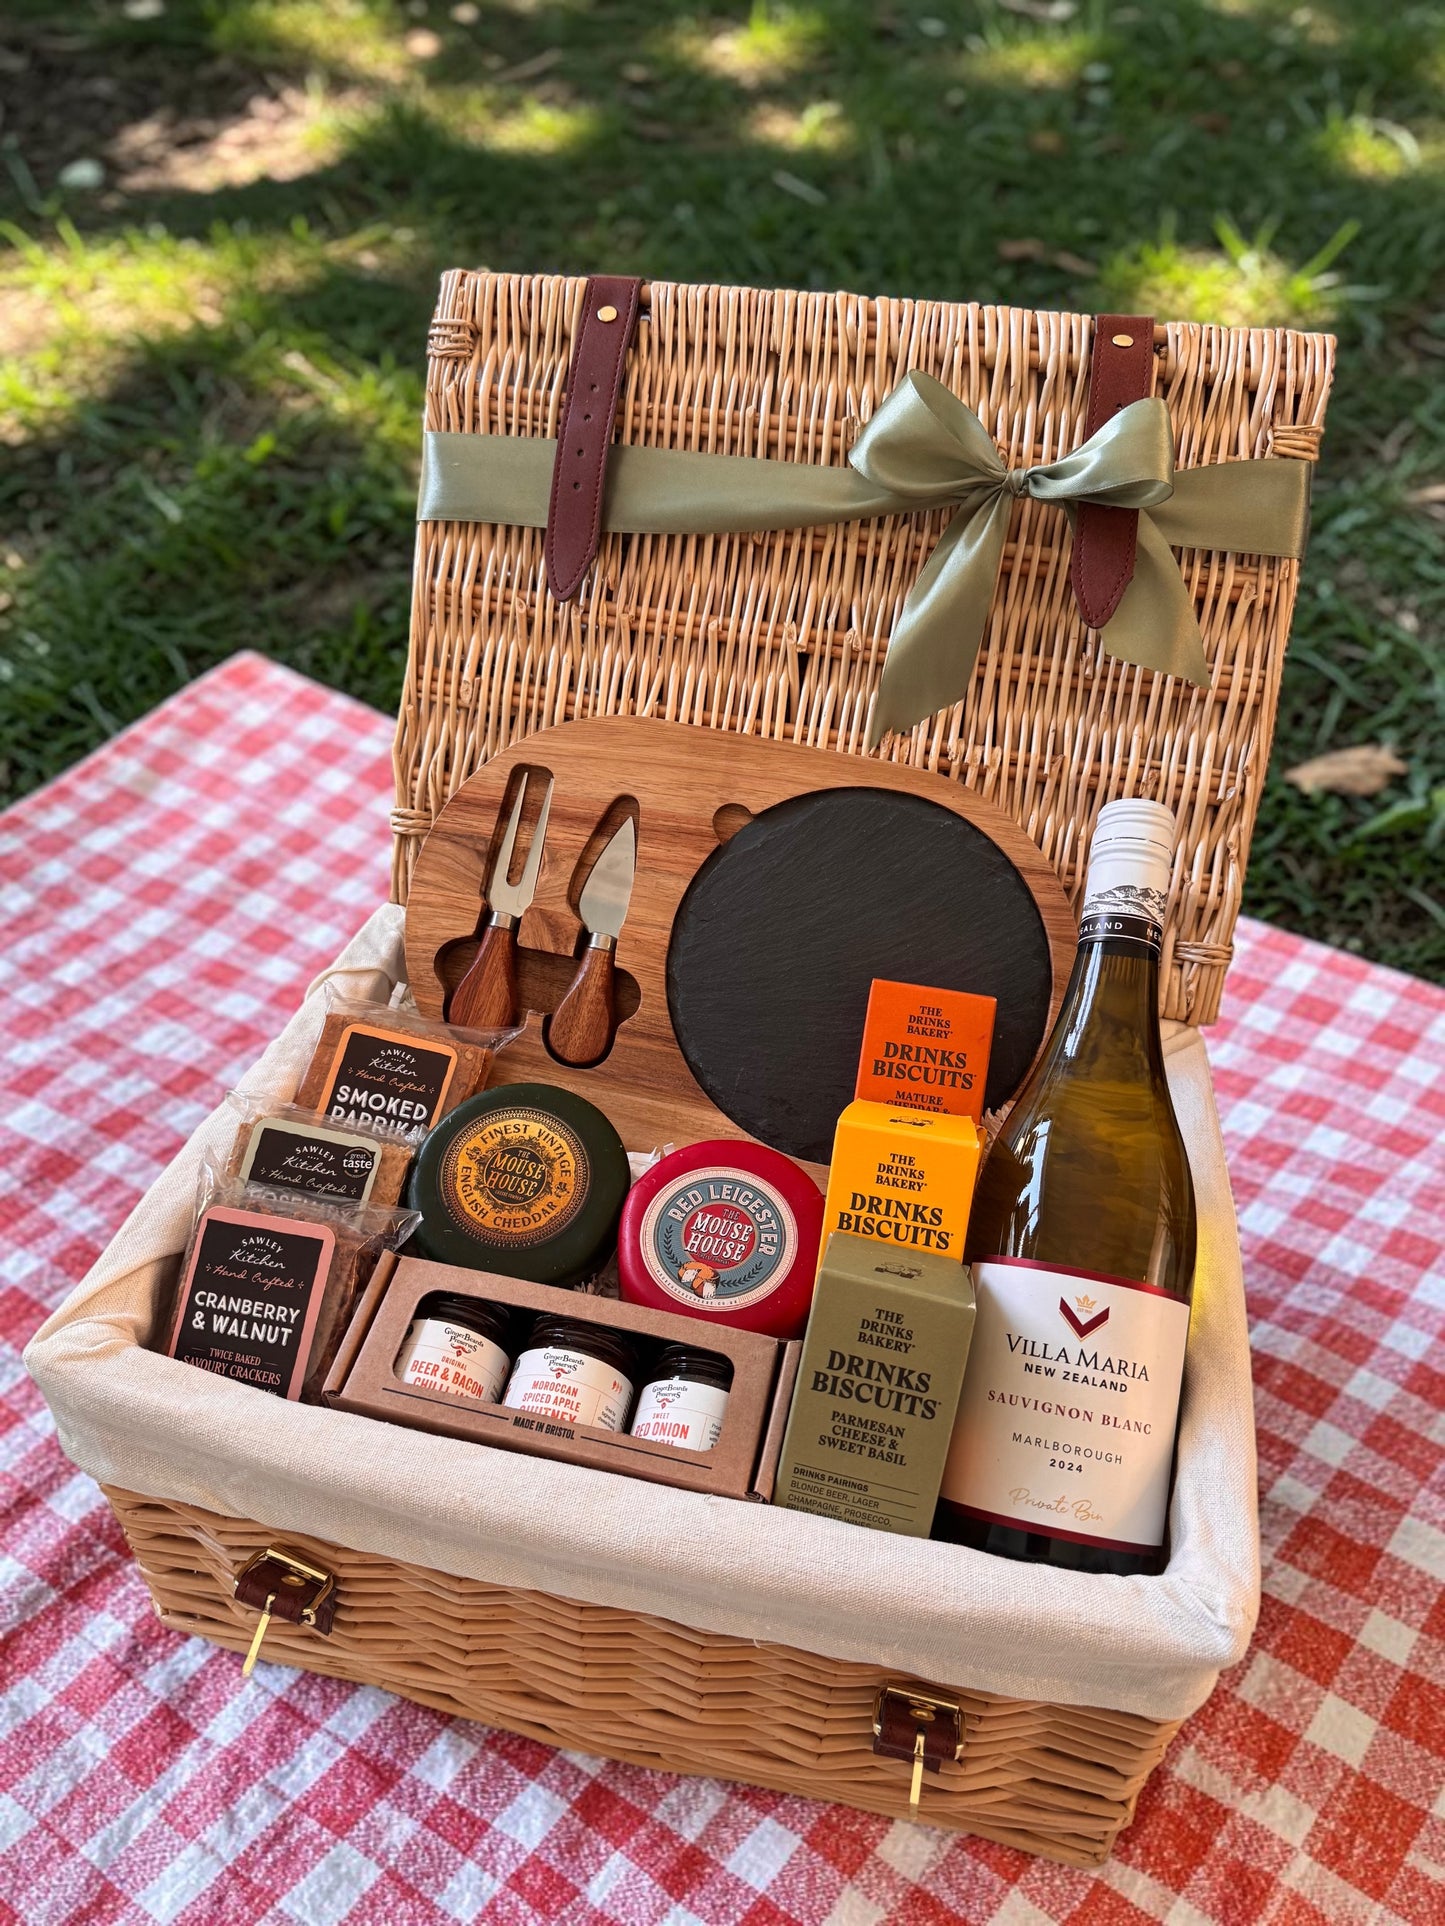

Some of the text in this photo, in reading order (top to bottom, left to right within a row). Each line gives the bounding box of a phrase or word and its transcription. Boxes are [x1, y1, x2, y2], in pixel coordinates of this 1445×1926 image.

[908, 1015, 951, 1028] DRINKS
[920, 1006, 942, 1016] THE
[906, 1026, 951, 1039] BAKERY
[368, 1058, 418, 1077] Kitchen
[380, 1049, 416, 1064] SAWLEY
[883, 1042, 967, 1069] DRINKS
[356, 1069, 426, 1092] Hand Crafted
[872, 1060, 974, 1090] BISCUITS
[336, 1085, 428, 1120] SMOKED
[896, 1091, 944, 1106] MATURE
[480, 1124, 530, 1145] FINEST
[296, 1146, 336, 1162] SAWLEY
[342, 1160, 373, 1170] taste
[518, 1150, 530, 1158] THE
[537, 1128, 571, 1178] VINTAGE
[890, 1153, 916, 1166] THE
[282, 1156, 337, 1176] Kitchen
[490, 1152, 546, 1180] MOUSE
[878, 1163, 925, 1180] DRINKS
[268, 1169, 347, 1194] Hand Crafted
[460, 1166, 489, 1219] ENGLISH
[486, 1171, 538, 1197] HOUSE
[876, 1175, 925, 1192] BAKERY
[493, 1201, 557, 1228] CHEDDAR
[668, 1189, 704, 1222] RED
[722, 1208, 740, 1220] THE
[850, 1192, 942, 1226] DRINKS
[690, 1212, 753, 1242] MOUSE
[709, 1184, 778, 1256] LEICESTER
[837, 1212, 950, 1250] BISCUITS
[242, 1236, 284, 1253] SAWLEY
[684, 1232, 746, 1262] HOUSE
[228, 1248, 286, 1269] Kitchen
[212, 1265, 294, 1291] Hand Crafted
[194, 1290, 300, 1324] CRANBERRY
[876, 1308, 904, 1325] THE
[192, 1311, 293, 1346] & WALNUT
[860, 1319, 914, 1340] DRINKS
[858, 1332, 912, 1354] BAKERY
[210, 1348, 262, 1366] TWICE BAKED
[441, 1356, 468, 1371] ORIGINAL
[1006, 1334, 1150, 1382] VILLA MARIA
[184, 1355, 282, 1386] SAVOURY CRACKERS
[410, 1360, 440, 1377] BEER
[440, 1368, 449, 1381] &
[452, 1372, 484, 1398] BACON
[827, 1350, 931, 1394] DRINKS
[1024, 1363, 1128, 1392] NEW ZEALAND
[532, 1380, 578, 1398] MOROCCAN
[811, 1370, 938, 1420] BISCUITS
[522, 1392, 582, 1412] SPICED APPLE
[988, 1390, 1152, 1434] SAUVIGNON BLANC
[513, 1416, 575, 1440] MADE IN BRISTOL
[652, 1422, 690, 1440] ONION
[832, 1410, 906, 1438] PARMESAN
[832, 1425, 899, 1450] CHEESE &
[1012, 1432, 1122, 1464] MARLBOROUGH
[818, 1435, 906, 1466] SWEET BASIL
[1050, 1458, 1083, 1472] 2024
[794, 1467, 868, 1492] DRINKS PAIRINGS
[790, 1480, 880, 1508] BLONDE BEER, LAGER
[1009, 1488, 1104, 1522] Private Bin
[788, 1494, 892, 1526] CHAMPAGNE, PROSECCO,
